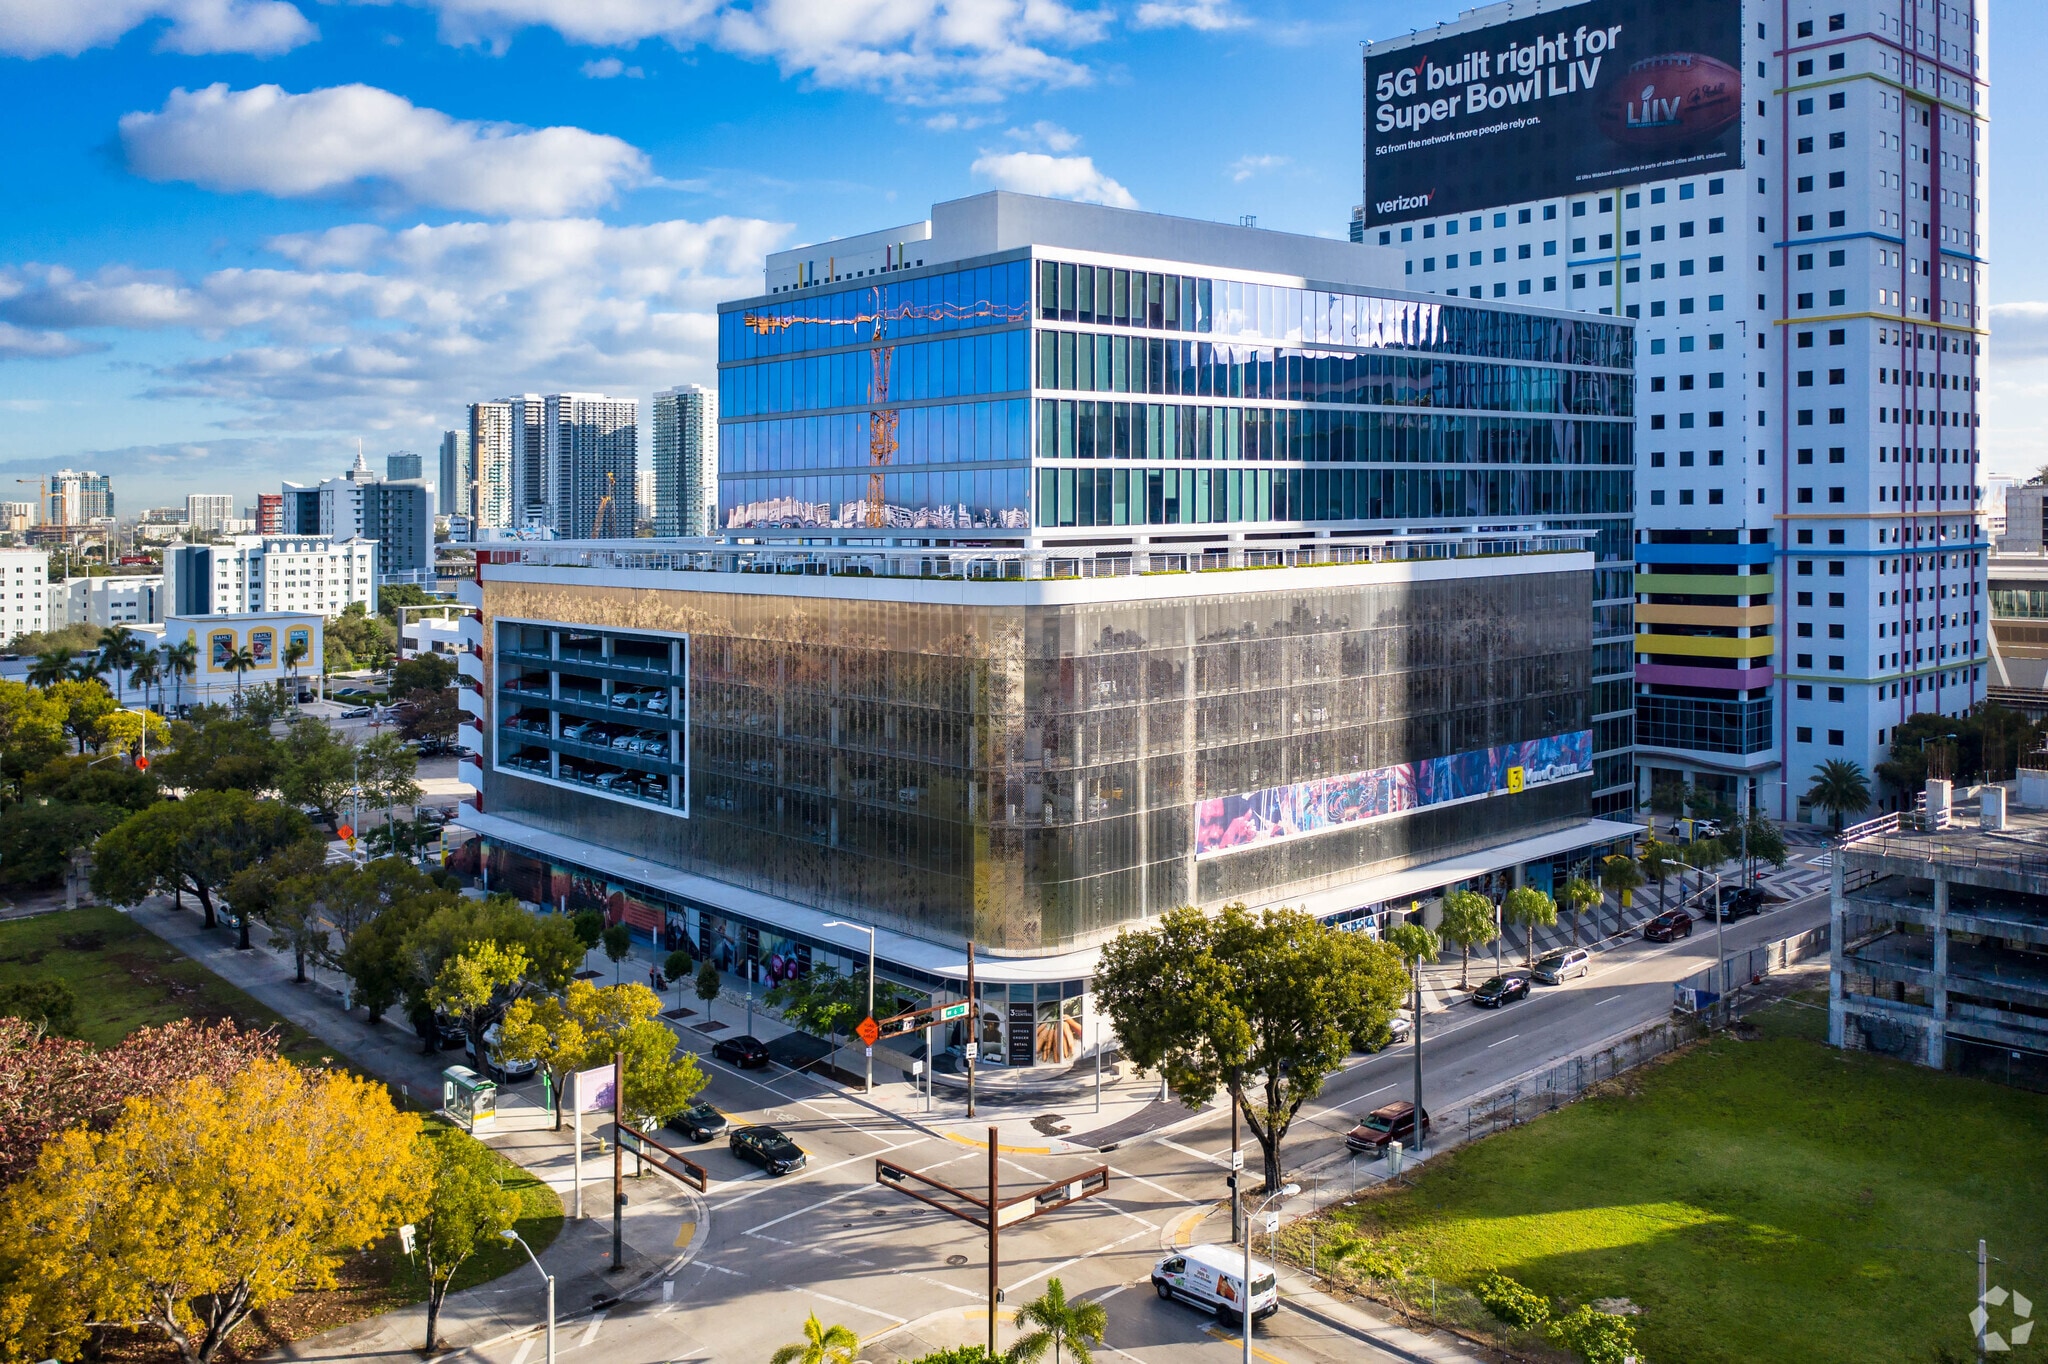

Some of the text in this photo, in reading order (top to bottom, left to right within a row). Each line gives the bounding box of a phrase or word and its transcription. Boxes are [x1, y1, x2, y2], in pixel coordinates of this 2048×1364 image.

[1376, 24, 1622, 102] 5G built right for
[1375, 56, 1602, 133] Super Bowl LIV
[1627, 95, 1681, 124] LIV
[1375, 116, 1541, 156] 5G from the network more people rely on.
[1376, 193, 1428, 214] verizon
